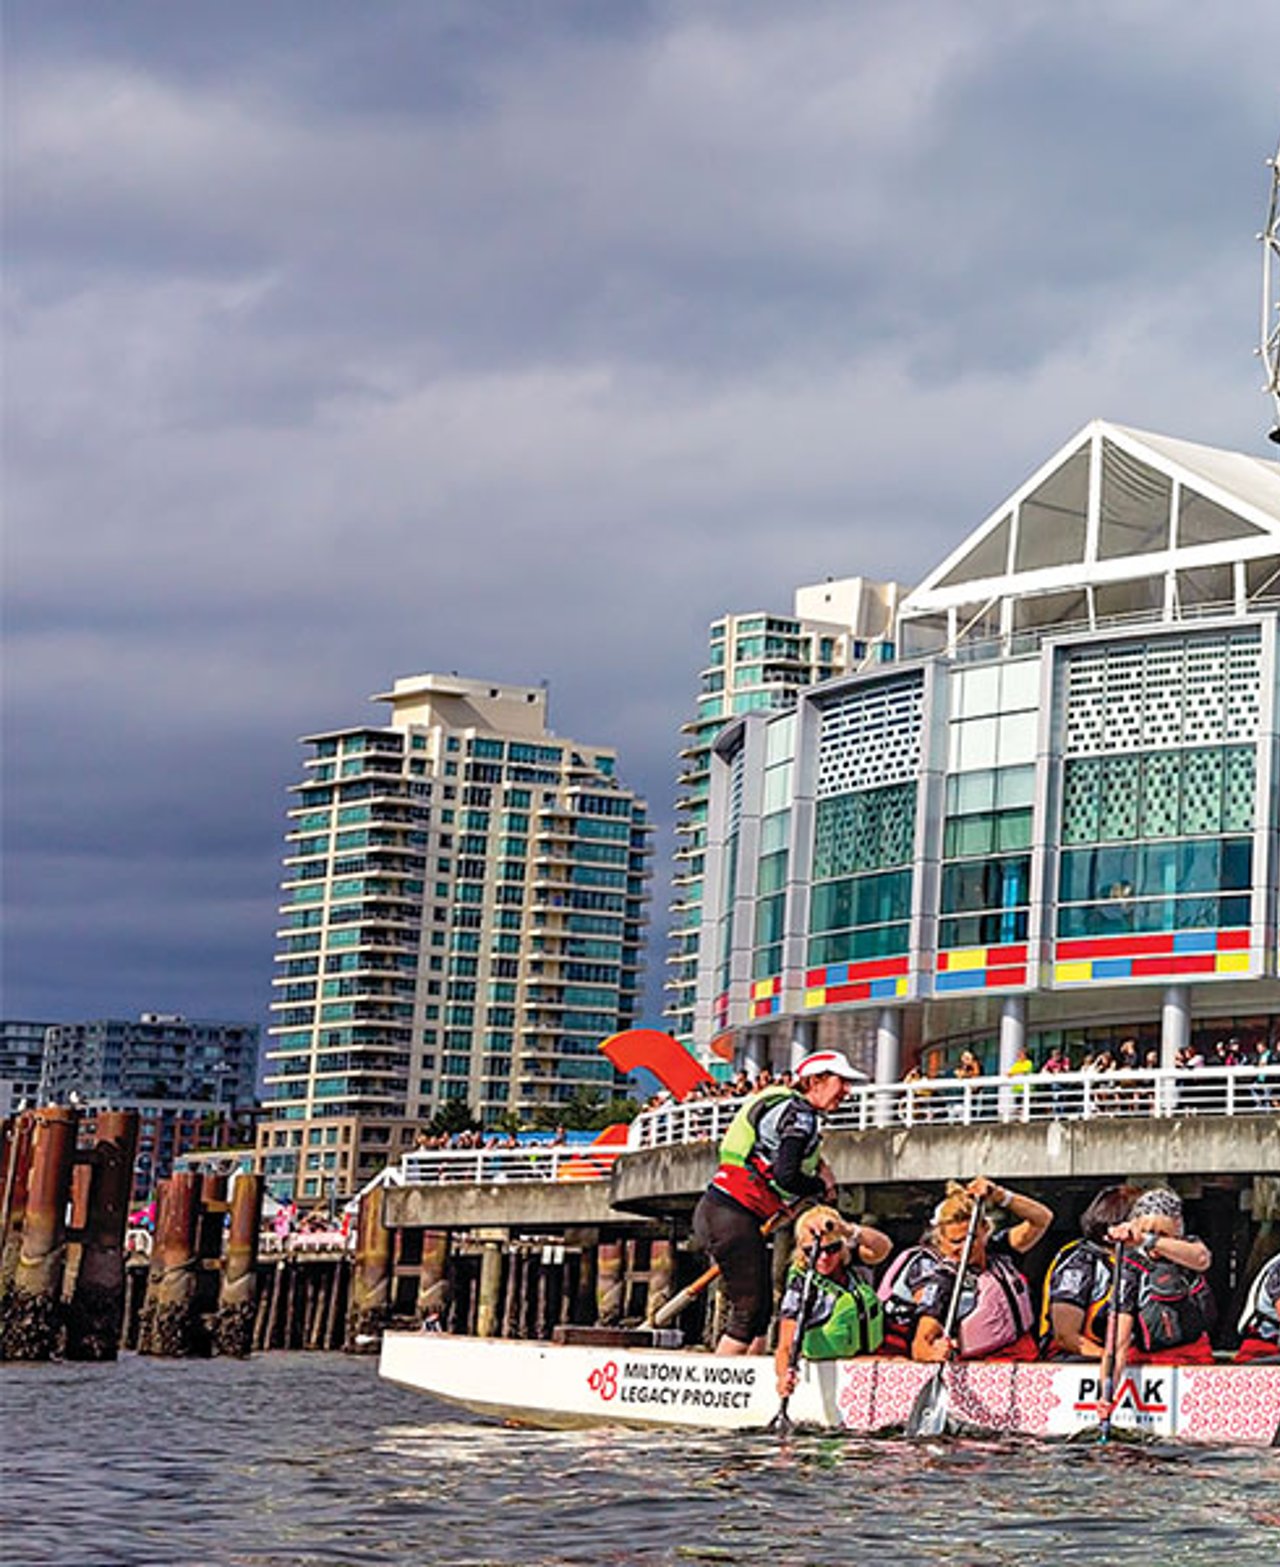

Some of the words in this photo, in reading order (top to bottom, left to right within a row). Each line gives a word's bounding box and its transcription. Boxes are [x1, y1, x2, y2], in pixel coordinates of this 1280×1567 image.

[624, 1362, 682, 1382] MILTON
[685, 1365, 700, 1383] K.
[704, 1367, 756, 1386] WONG
[620, 1386, 679, 1405] LEGACY
[682, 1388, 751, 1408] PROJECT
